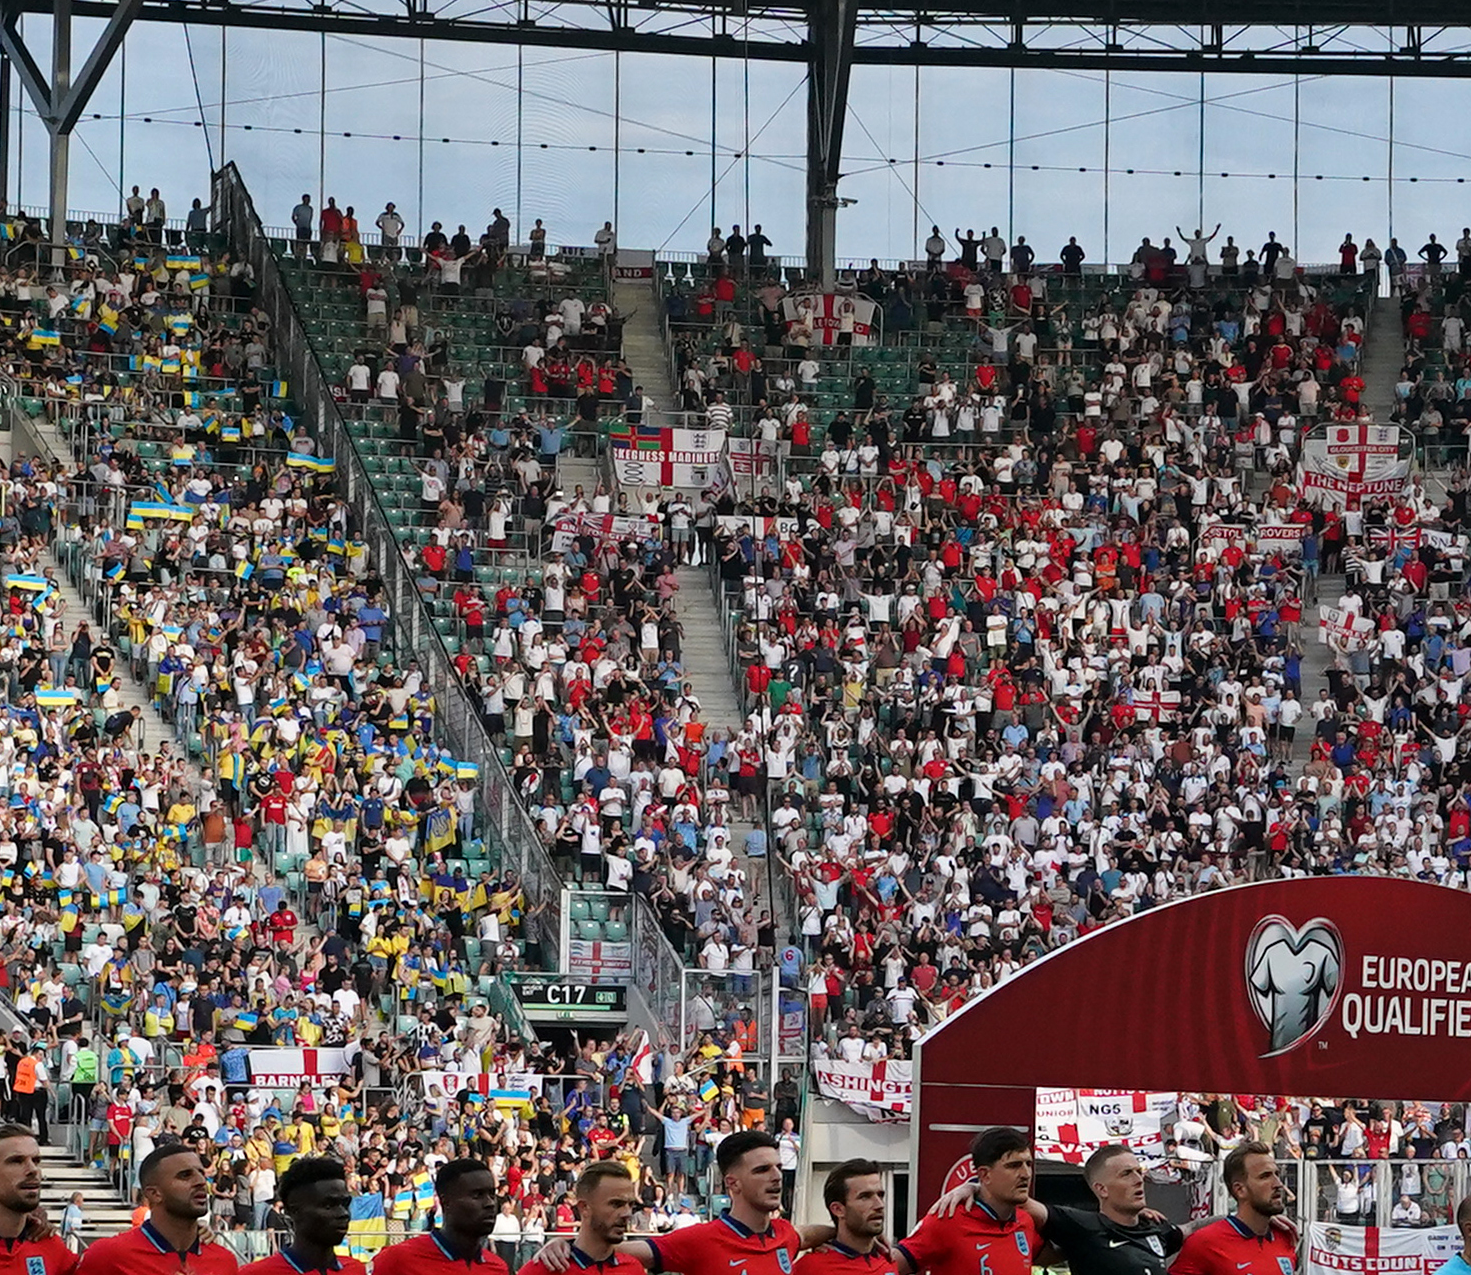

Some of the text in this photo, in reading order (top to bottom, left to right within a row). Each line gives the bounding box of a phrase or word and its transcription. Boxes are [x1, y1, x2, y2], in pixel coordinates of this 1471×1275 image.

[1329, 445, 1395, 455] GLOUCESTER CITY
[1309, 472, 1403, 494] THE NEPTUNE
[1260, 528, 1301, 538] ROVERS
[547, 985, 586, 1004] C17
[1089, 1102, 1122, 1115] NG5
